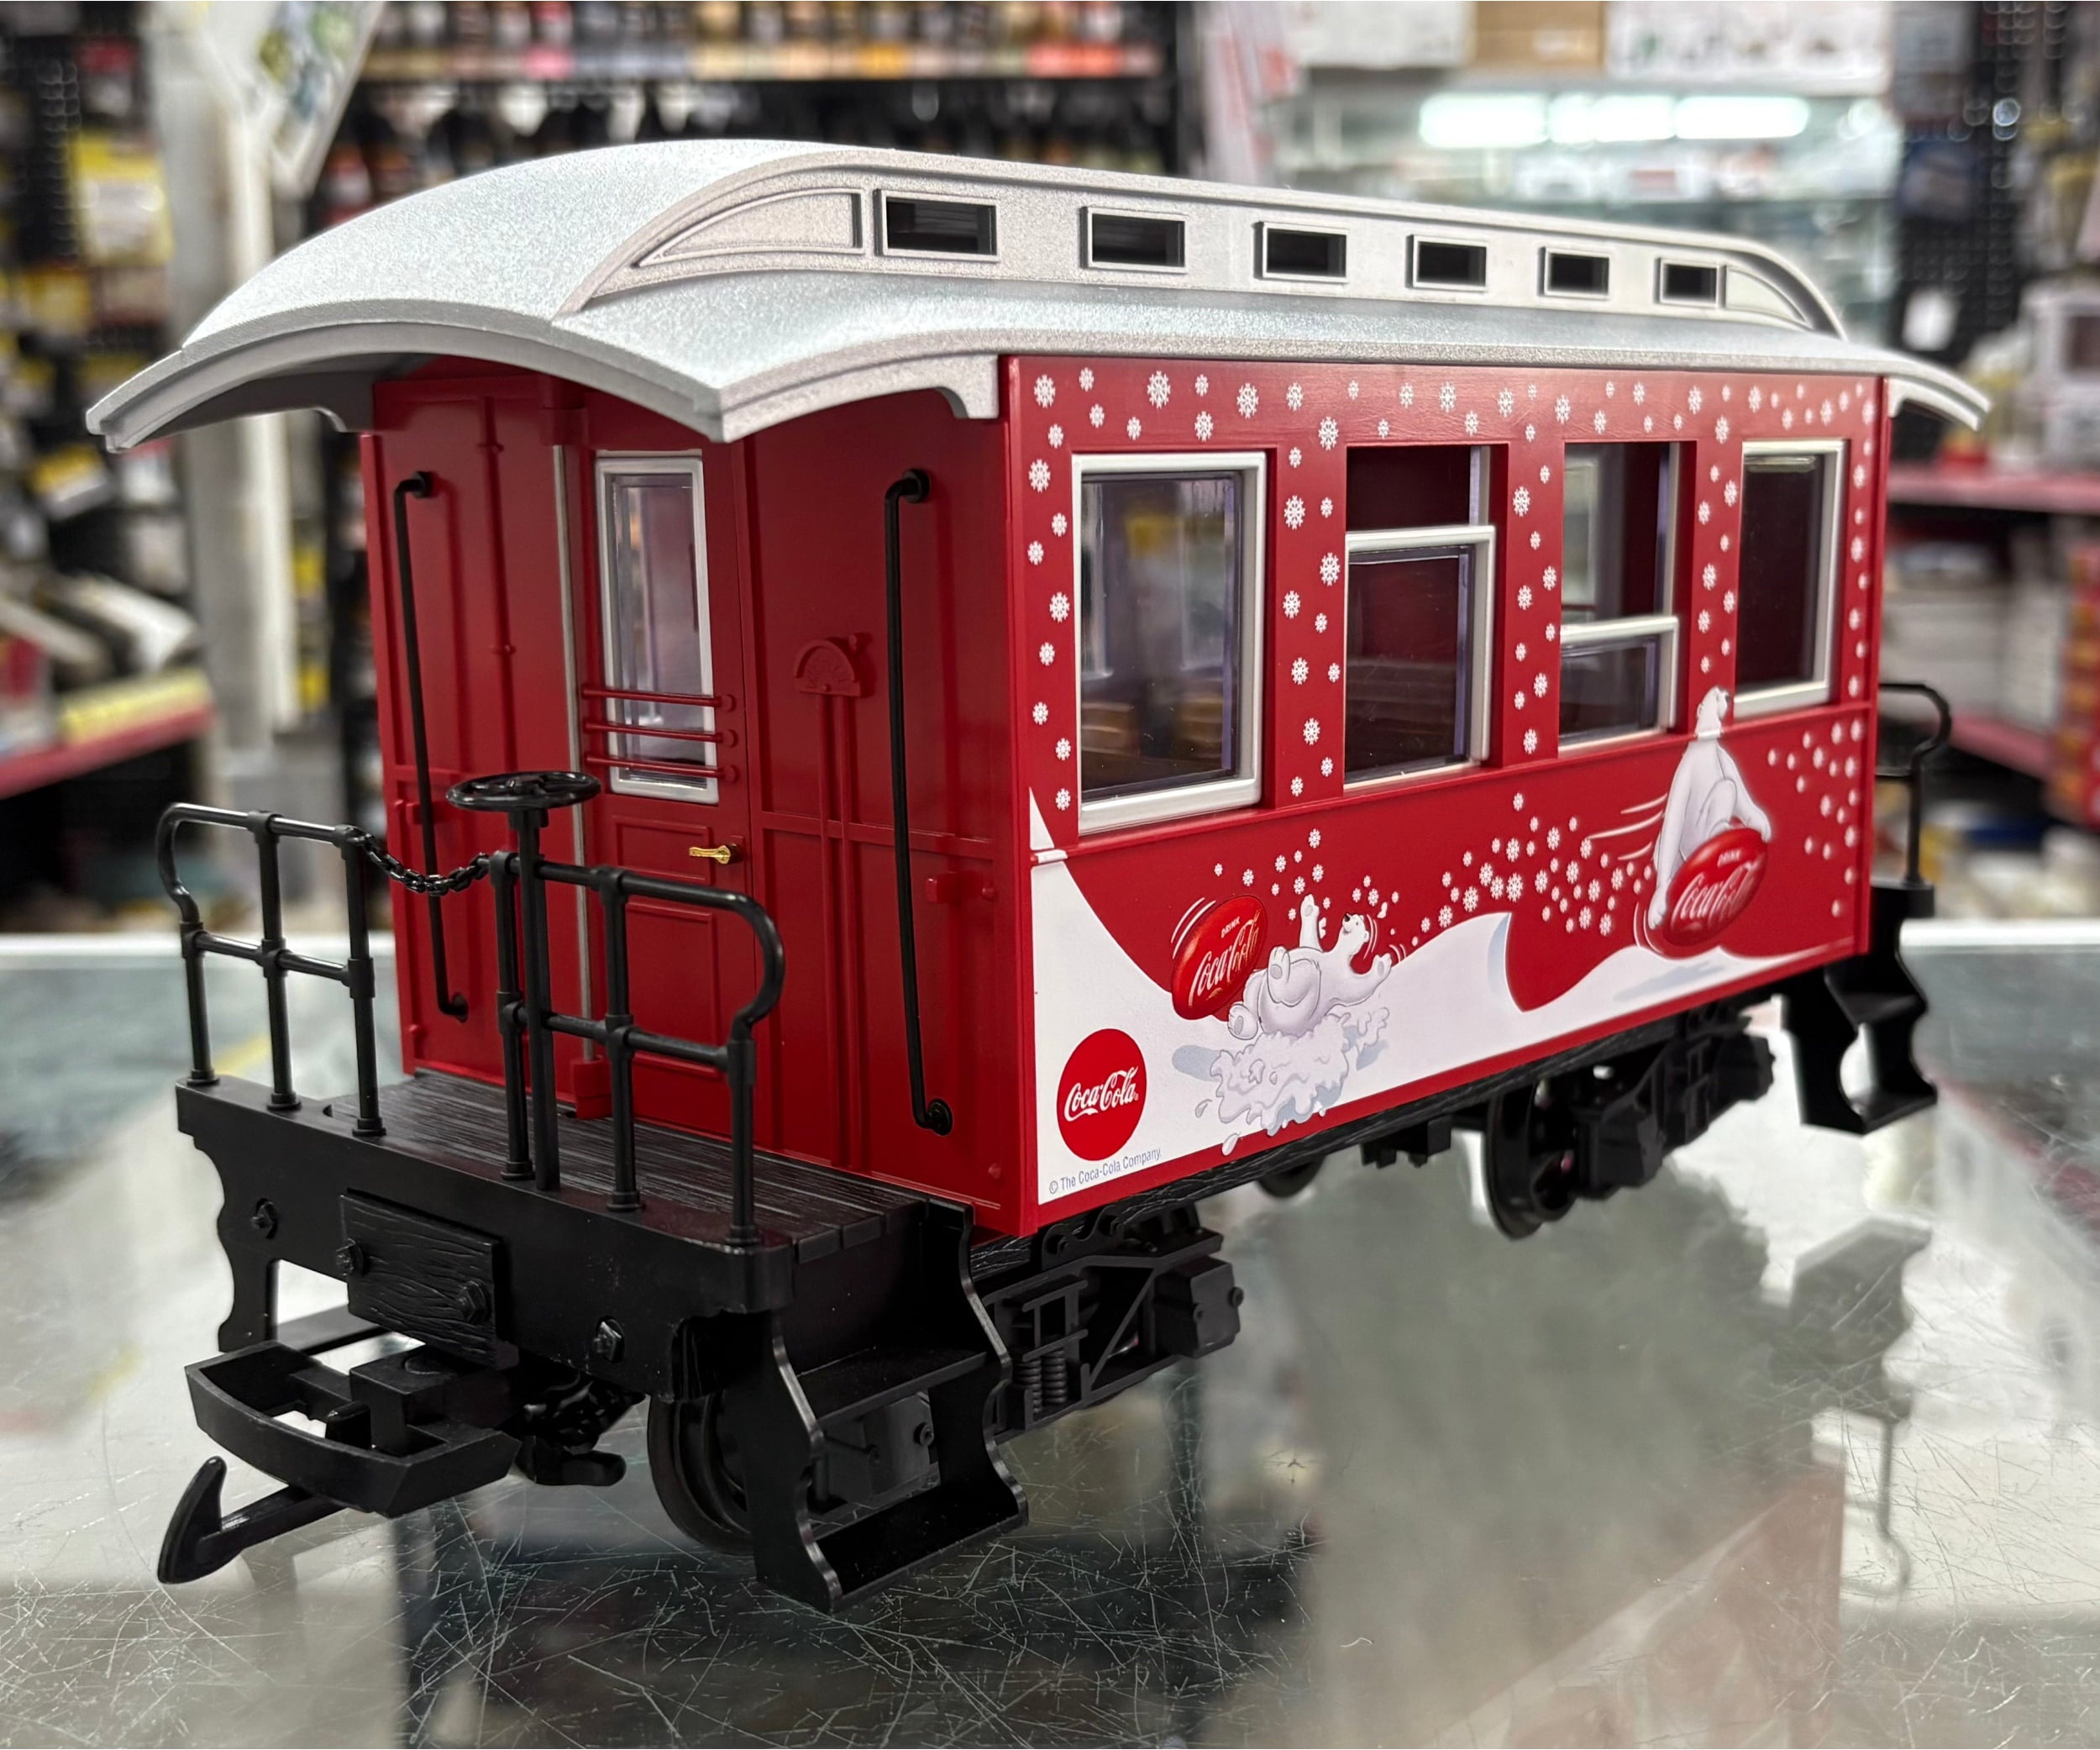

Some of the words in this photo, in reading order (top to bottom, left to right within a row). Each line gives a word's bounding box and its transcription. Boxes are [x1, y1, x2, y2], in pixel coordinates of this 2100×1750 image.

[1221, 916, 1241, 938] DRINK
[1060, 1175, 1076, 1190] The
[1079, 1160, 1121, 1184] Coca-Cola
